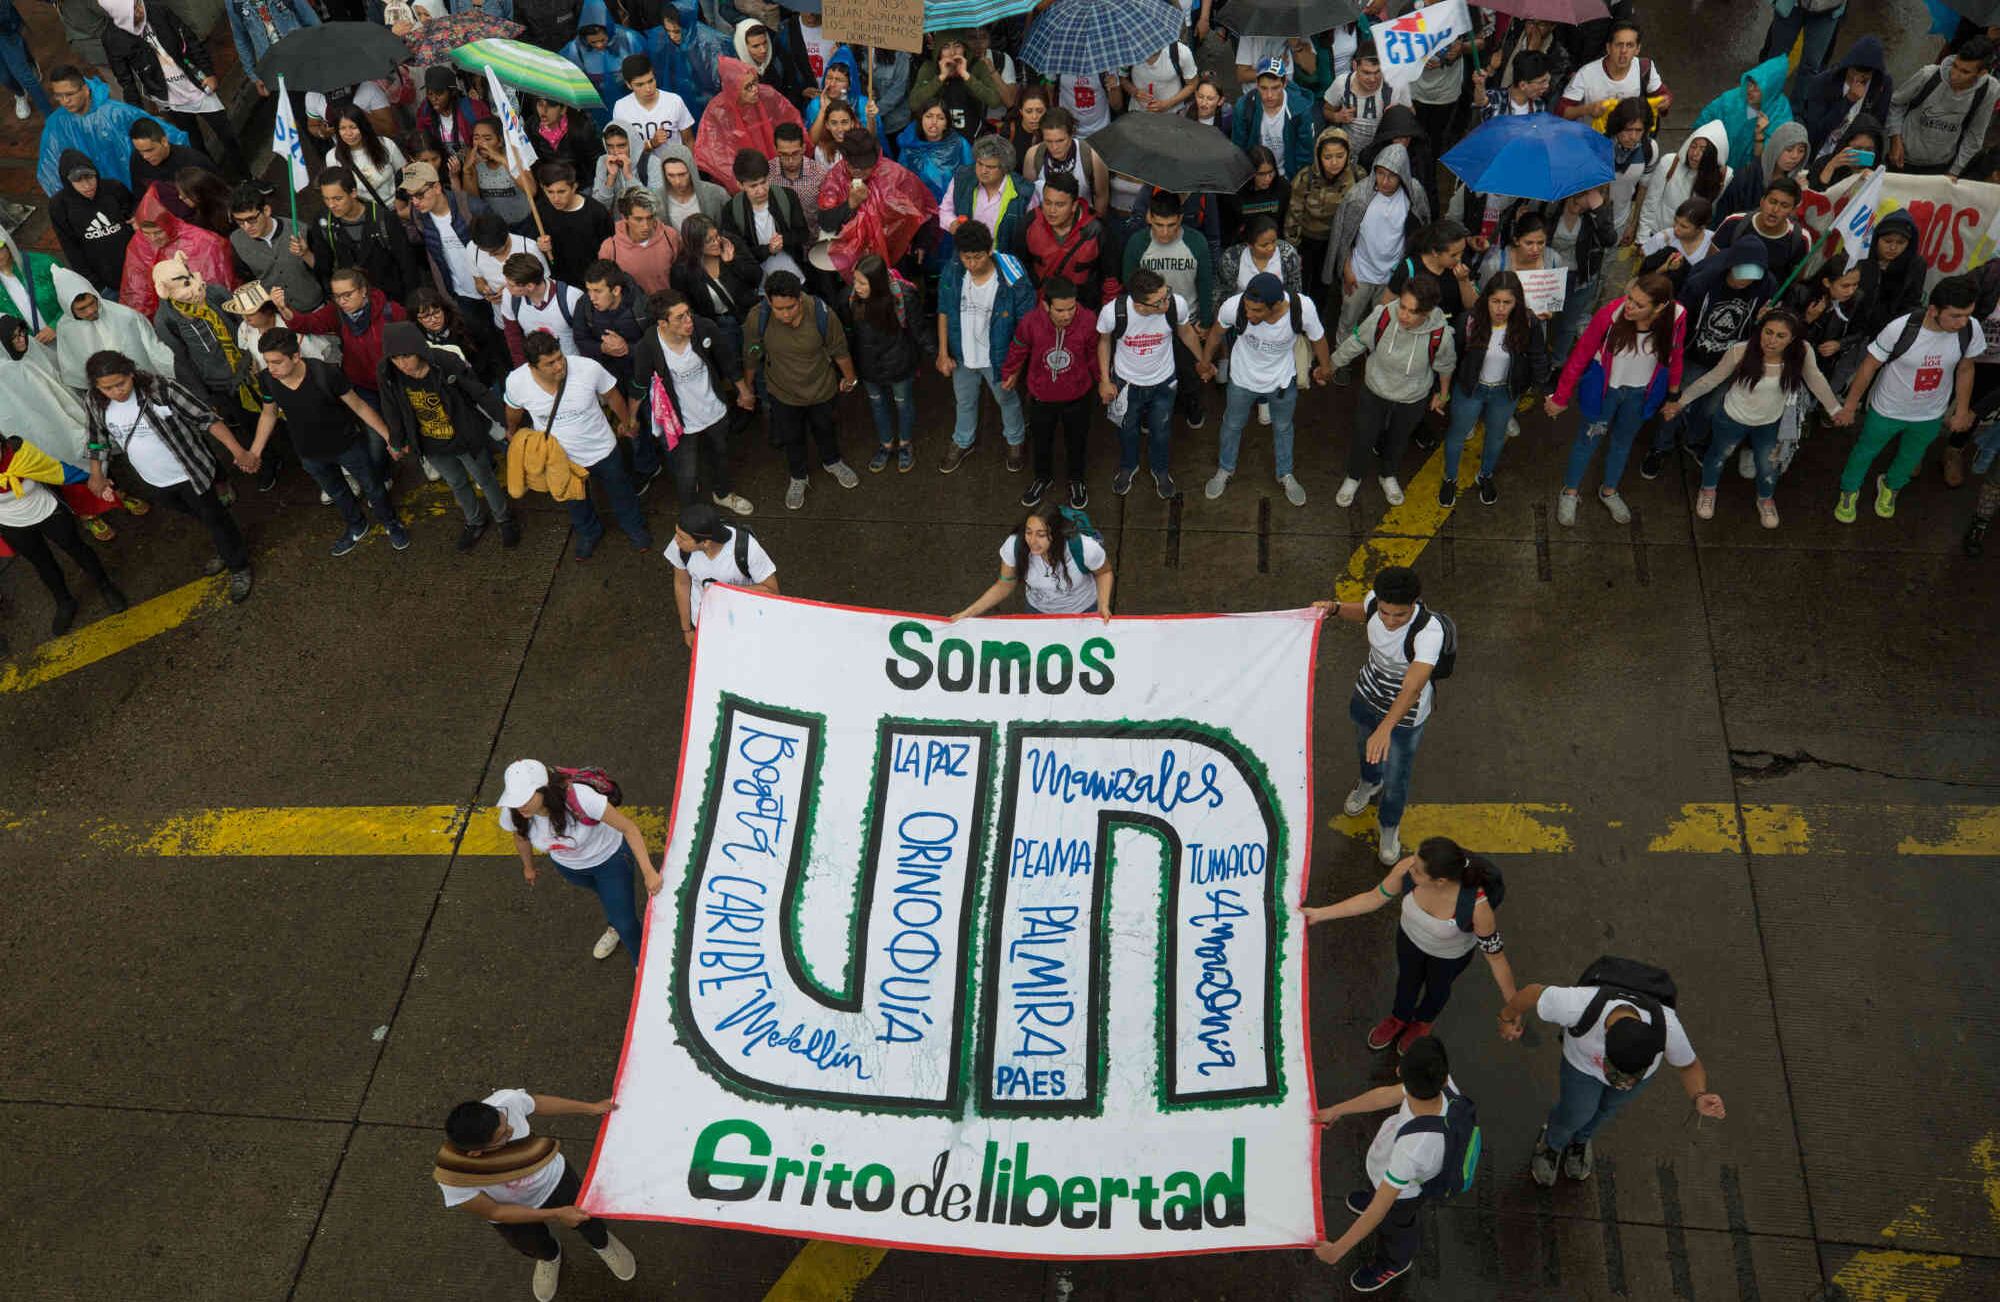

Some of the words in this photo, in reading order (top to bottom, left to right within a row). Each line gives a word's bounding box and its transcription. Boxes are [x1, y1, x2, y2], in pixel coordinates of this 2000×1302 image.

[84, 223, 121, 240] adidas
[1142, 256, 1197, 272] MONTREAL
[885, 620, 1116, 696] Somos
[722, 725, 800, 862] Bogotá
[893, 737, 921, 778] LA
[923, 739, 971, 787] PAZ
[1027, 748, 1224, 813] Manizales
[1010, 837, 1092, 878] PEAMA
[1186, 842, 1266, 885] TUMACO
[698, 875, 773, 997] CARIBE
[874, 811, 959, 1044] ORINOQUÍA
[1009, 905, 1079, 1058] PALMIRA
[714, 988, 873, 1080] Medellín
[995, 1065, 1067, 1097] PAES
[687, 1118, 896, 1213] Grito
[900, 1149, 972, 1222] de
[974, 1136, 1247, 1232] libertad
